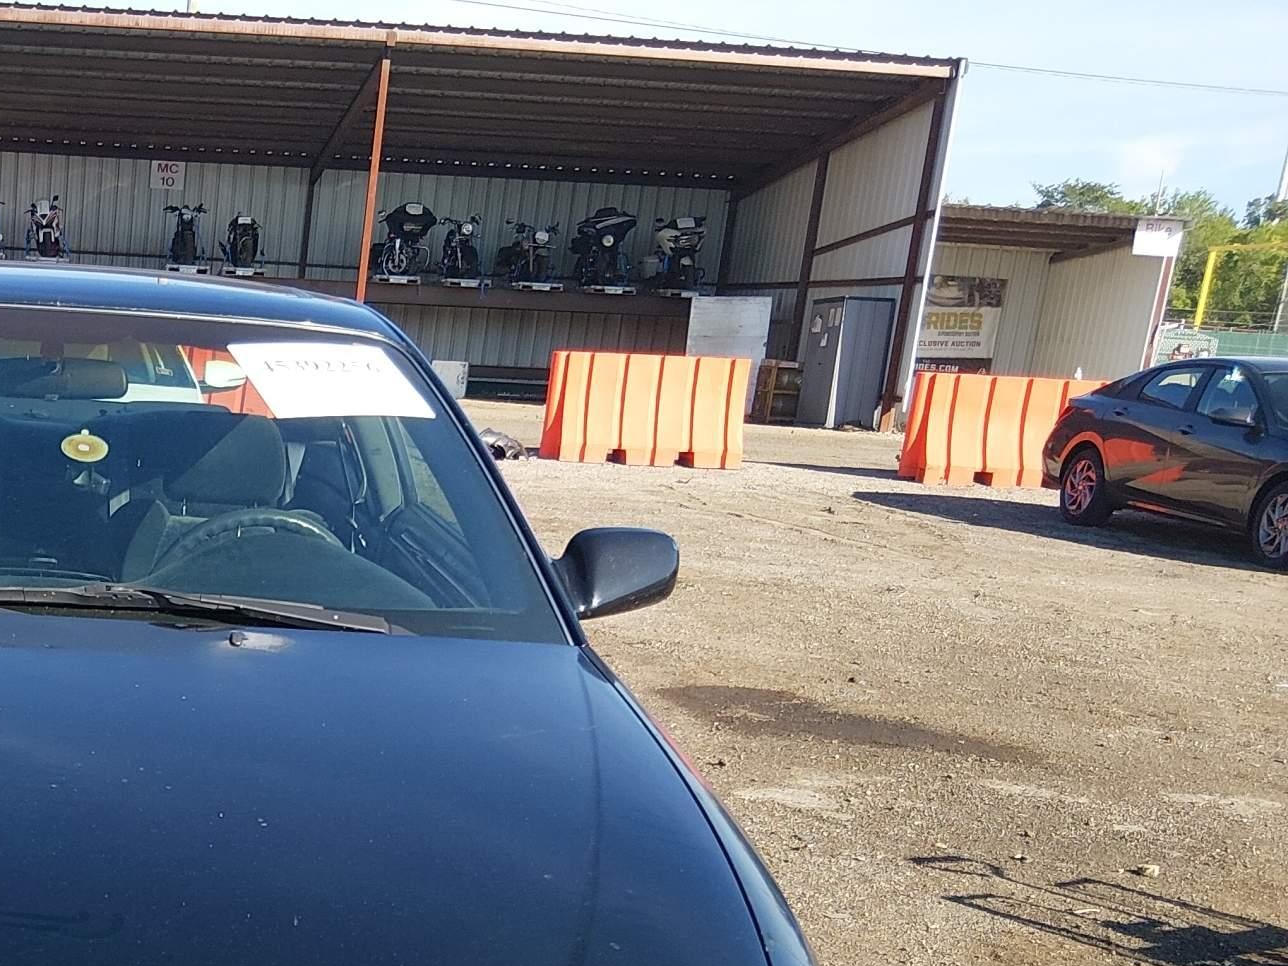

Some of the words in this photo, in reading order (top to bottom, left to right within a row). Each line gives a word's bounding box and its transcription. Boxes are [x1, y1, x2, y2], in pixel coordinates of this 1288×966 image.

[157, 163, 179, 174] MC
[160, 176, 175, 187] 10
[925, 312, 983, 330] RIDES
